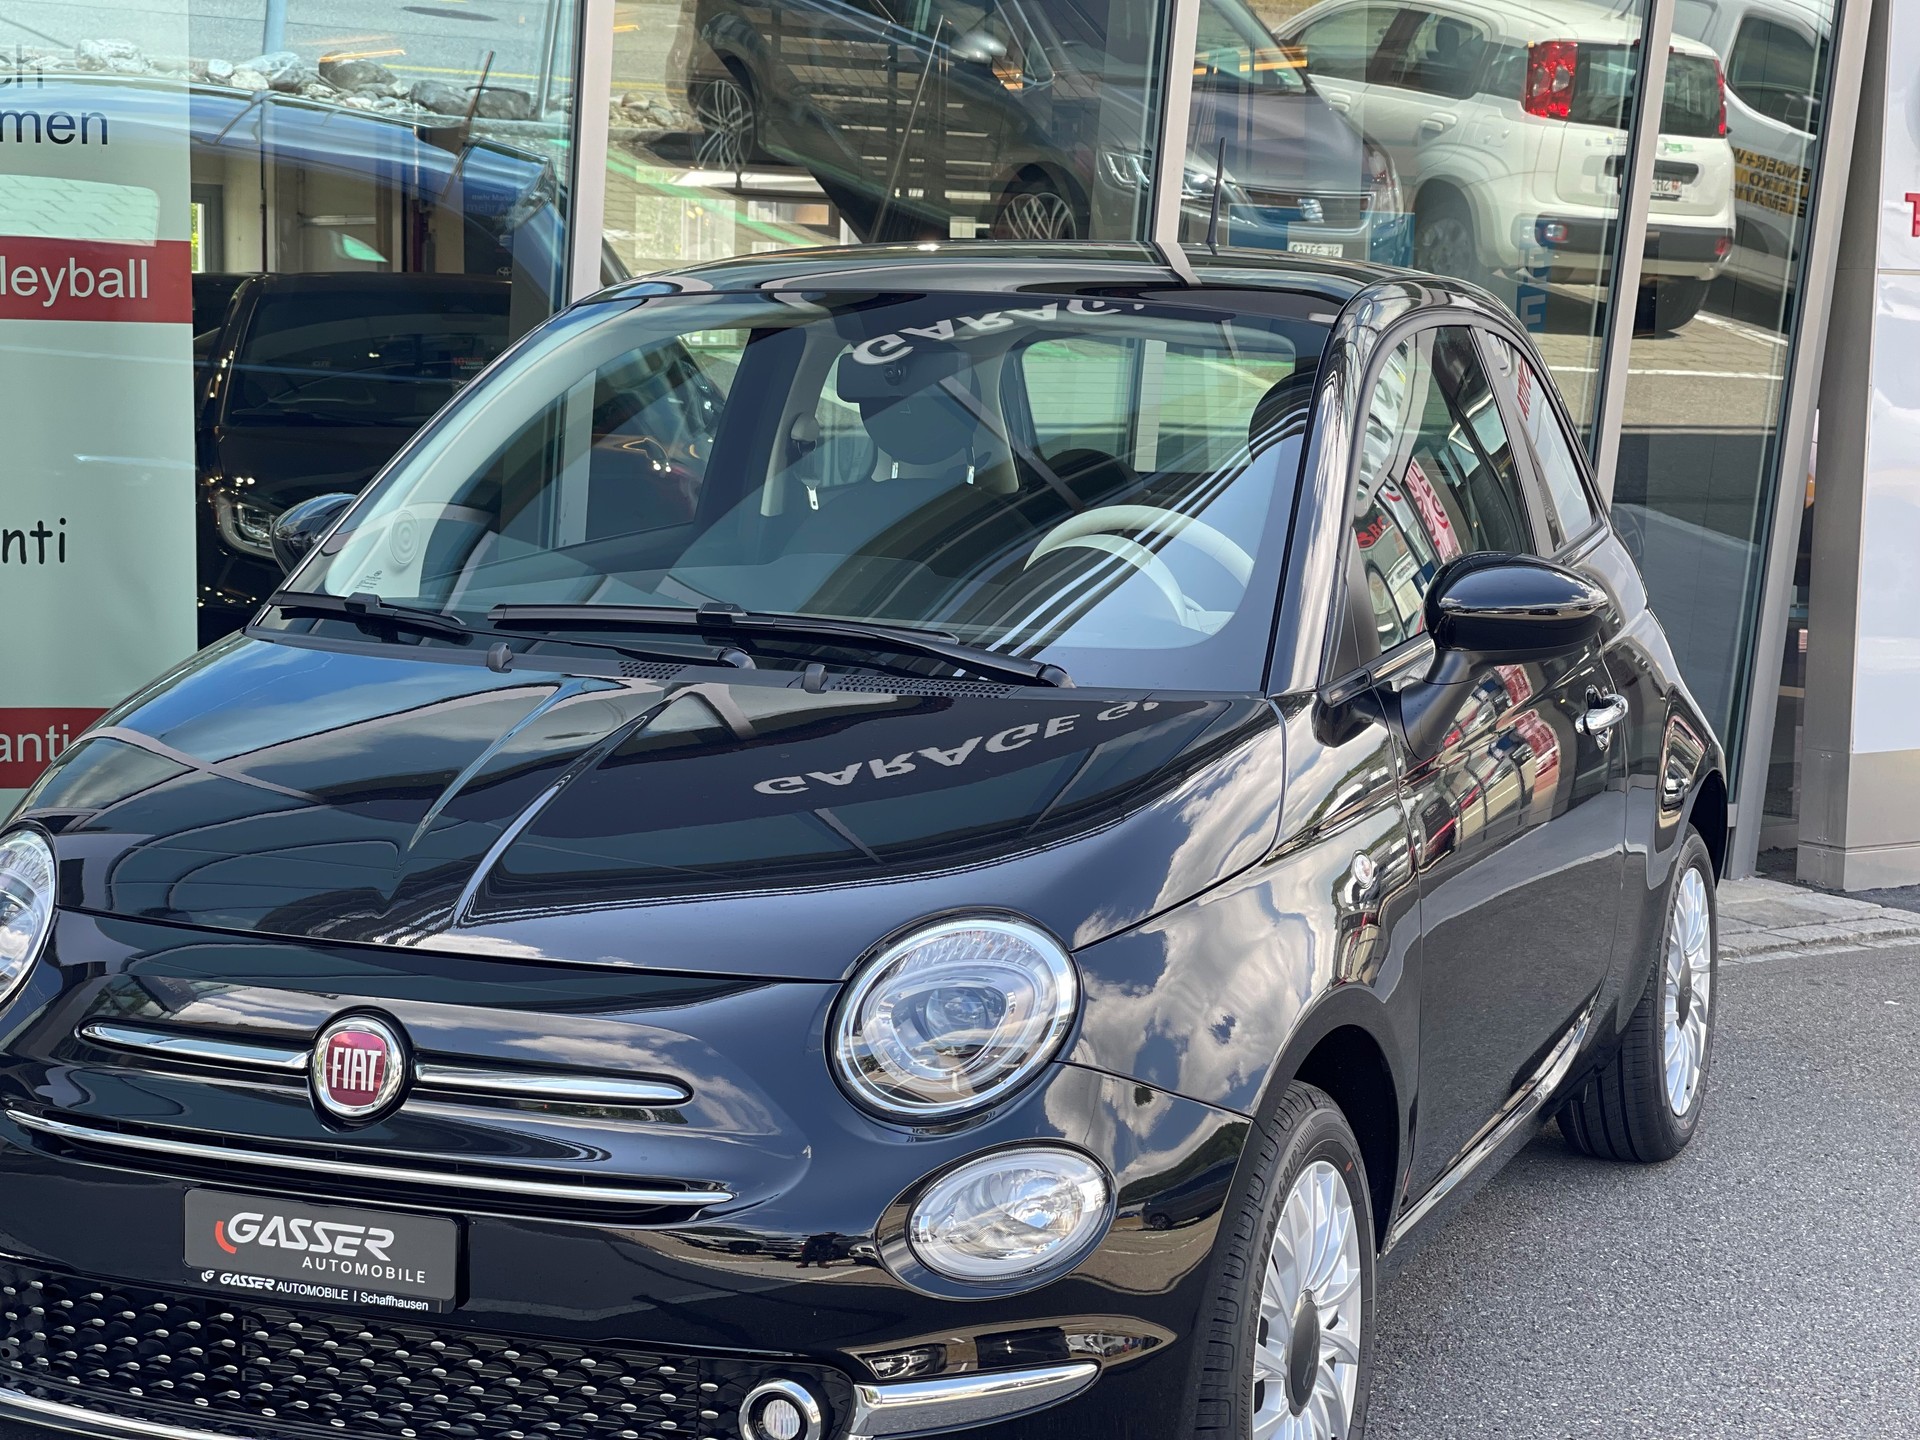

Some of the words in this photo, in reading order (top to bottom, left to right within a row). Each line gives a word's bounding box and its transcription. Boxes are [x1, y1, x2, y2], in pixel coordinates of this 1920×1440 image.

[0, 110, 108, 145] men
[0, 256, 148, 307] leyball
[2, 518, 67, 565] nti
[331, 1047, 382, 1091] FIAT
[228, 1212, 395, 1262] GASSER
[302, 1256, 426, 1283] AUTOMOBILE
[220, 1273, 275, 1290] GASSER
[276, 1282, 349, 1300] AUTOMOBILE
[360, 1292, 429, 1311] Schaffhausen
